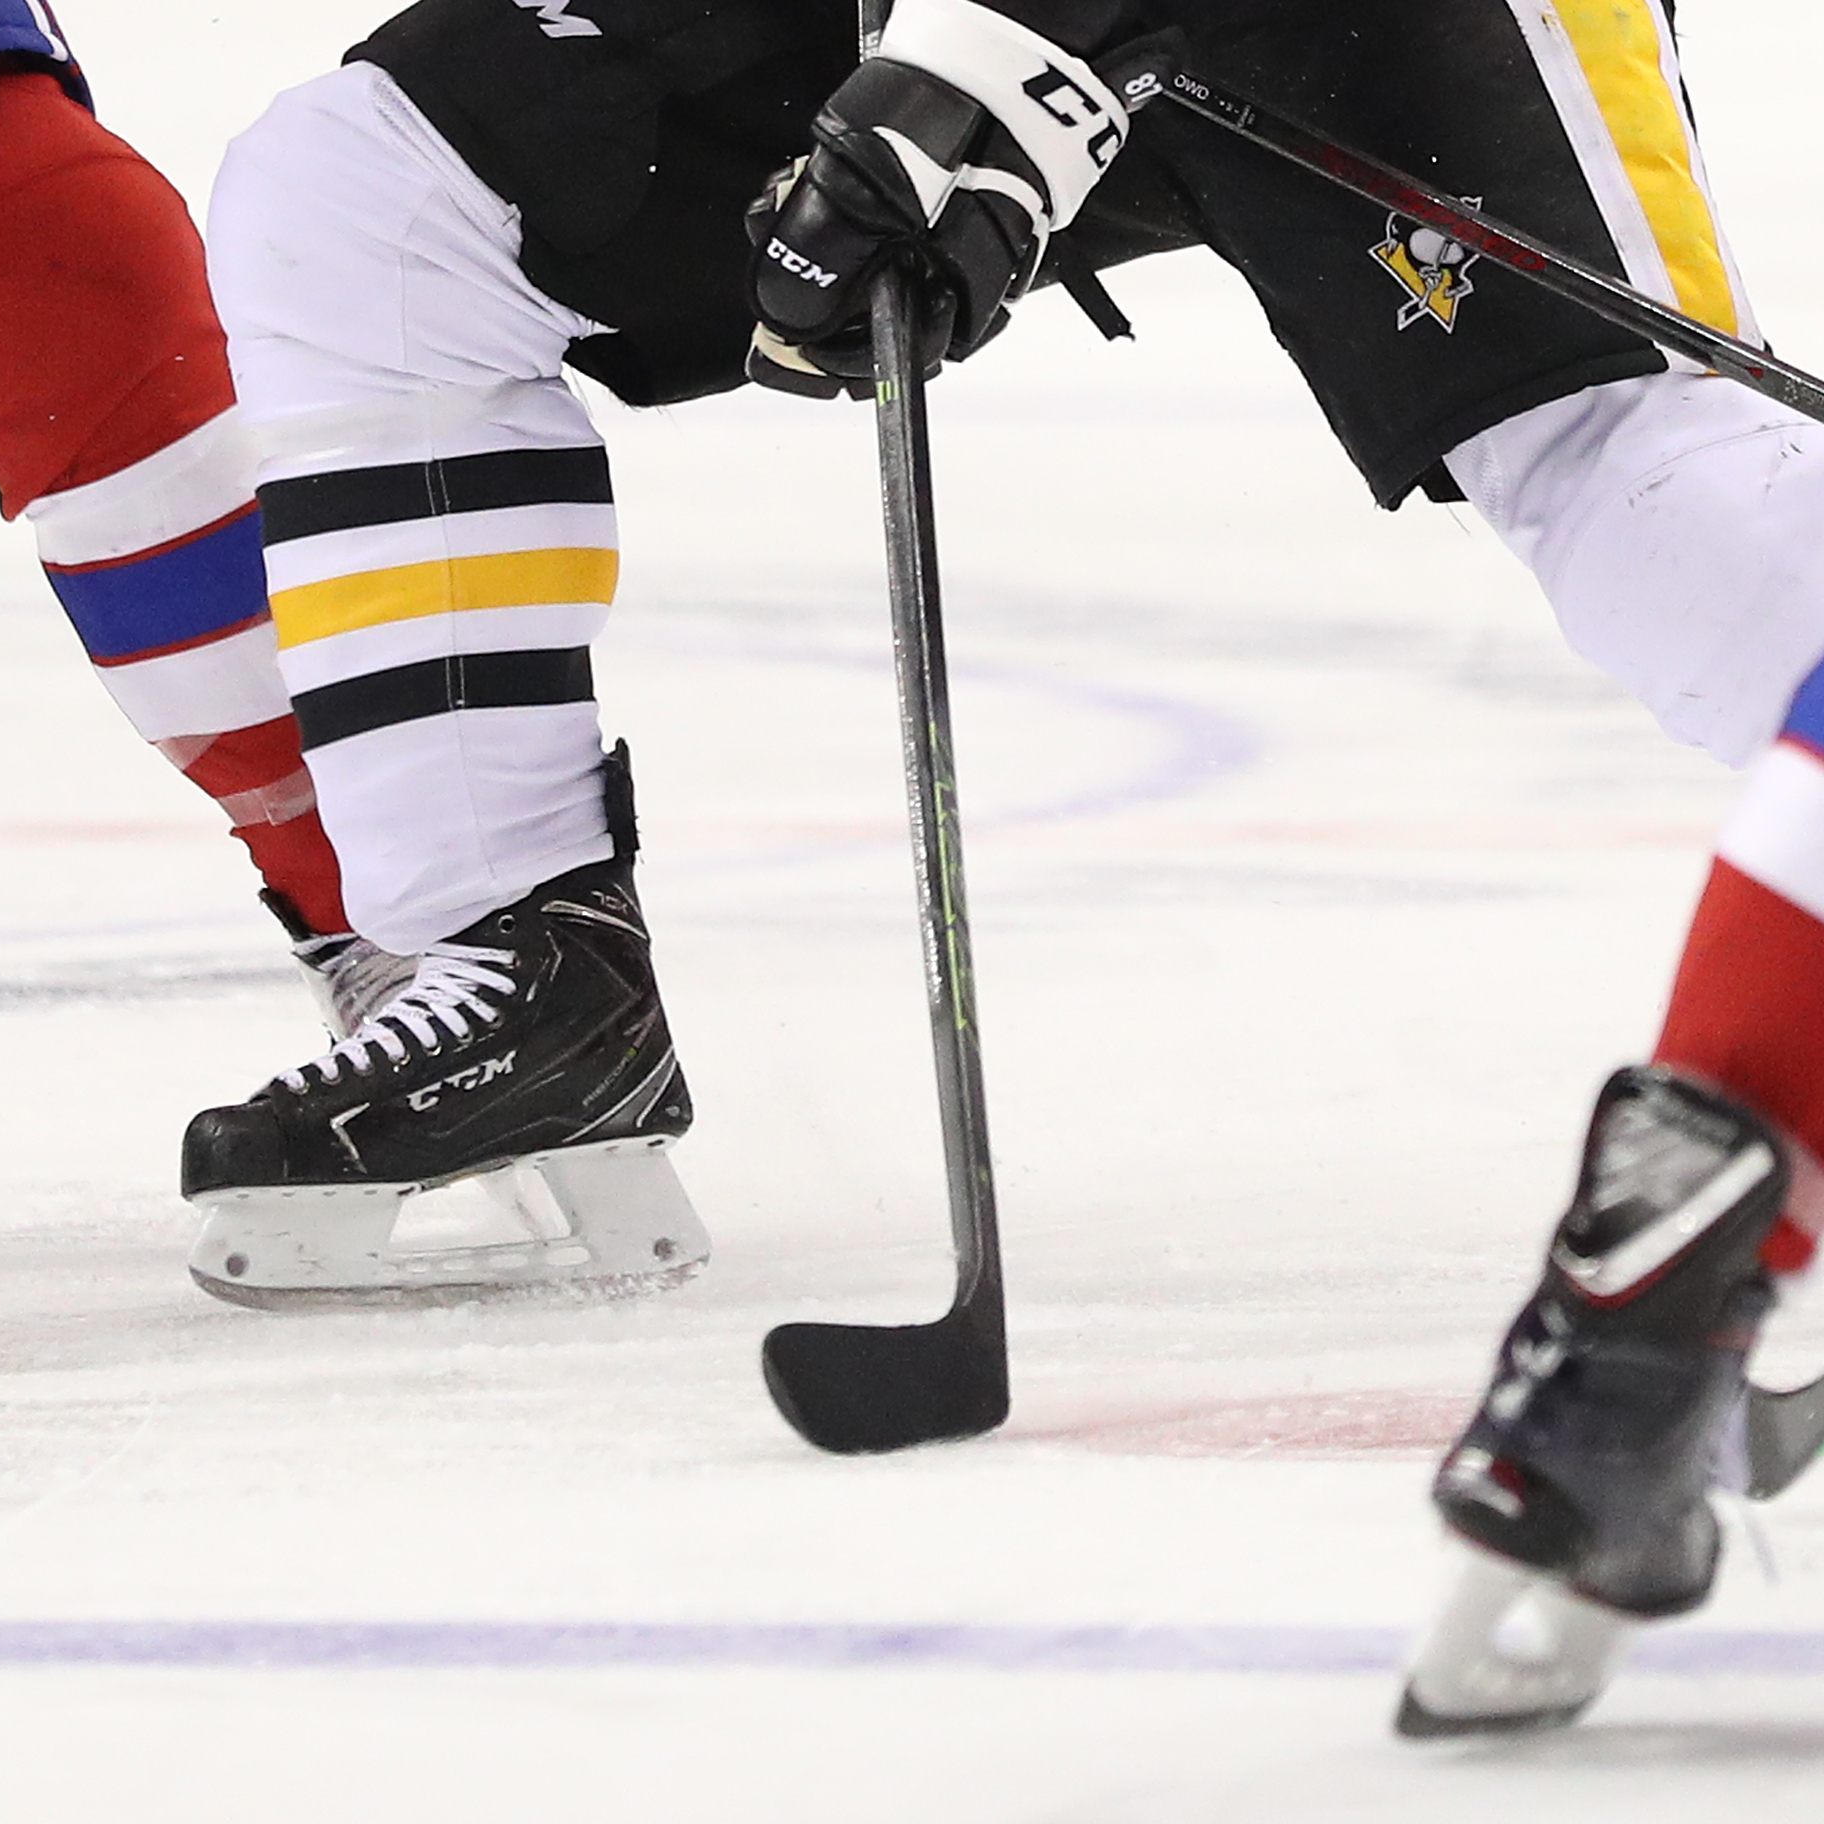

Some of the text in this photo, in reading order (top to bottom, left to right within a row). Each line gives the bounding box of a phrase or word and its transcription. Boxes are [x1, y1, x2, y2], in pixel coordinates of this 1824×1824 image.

[1173, 73, 1211, 102] OWD
[1021, 60, 1121, 169] CC
[766, 236, 839, 289] CCM
